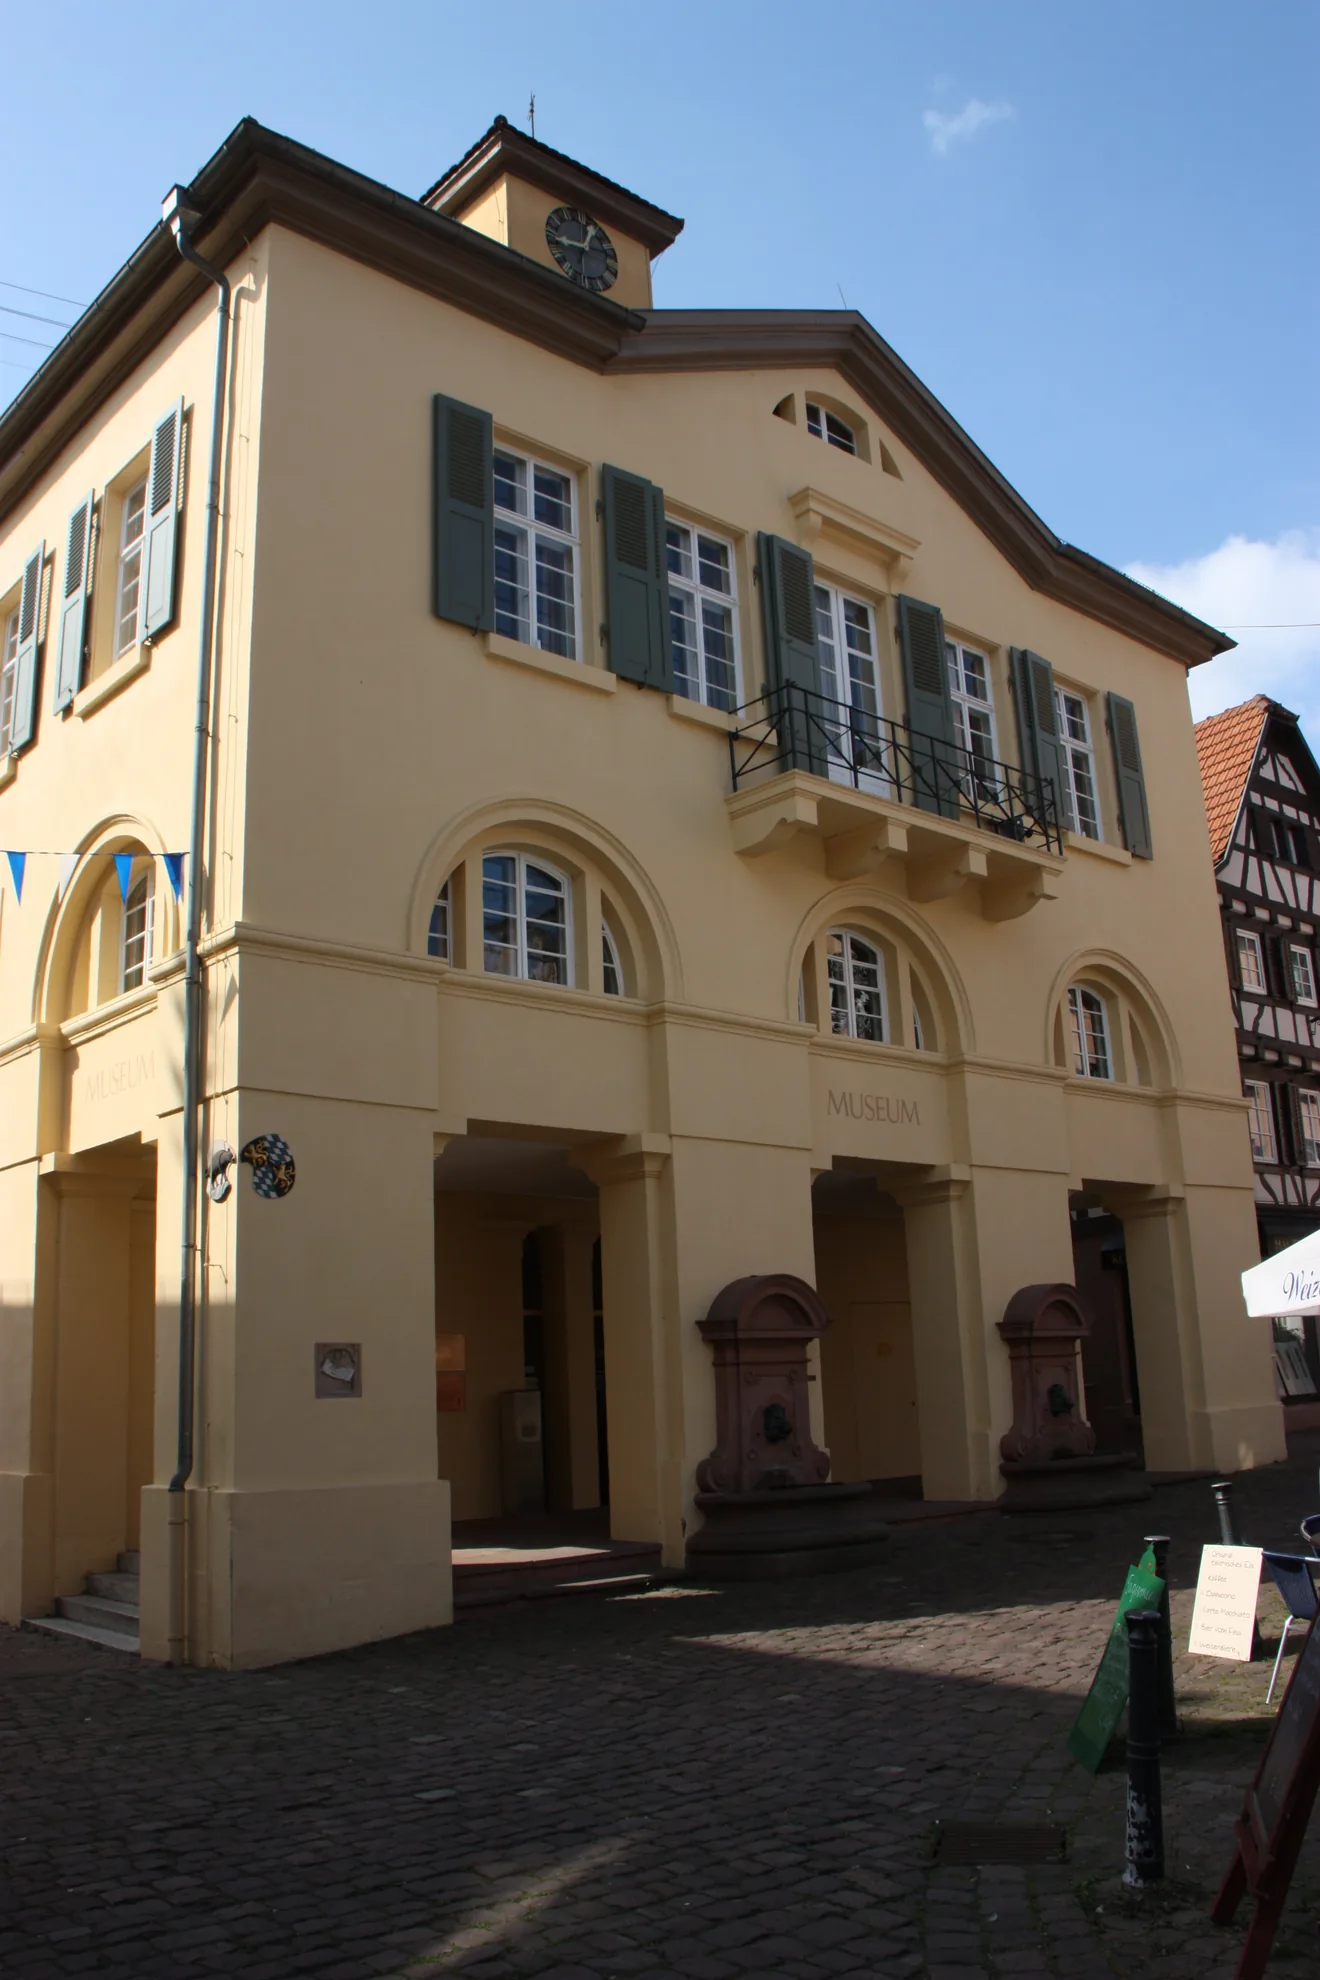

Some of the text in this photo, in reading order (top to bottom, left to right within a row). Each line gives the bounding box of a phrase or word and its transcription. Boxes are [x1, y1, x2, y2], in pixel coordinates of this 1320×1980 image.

[84, 1049, 155, 1104] MUSEUM
[827, 1089, 921, 1126] MUSEUM
[1283, 1270, 1320, 1303] Weiz
